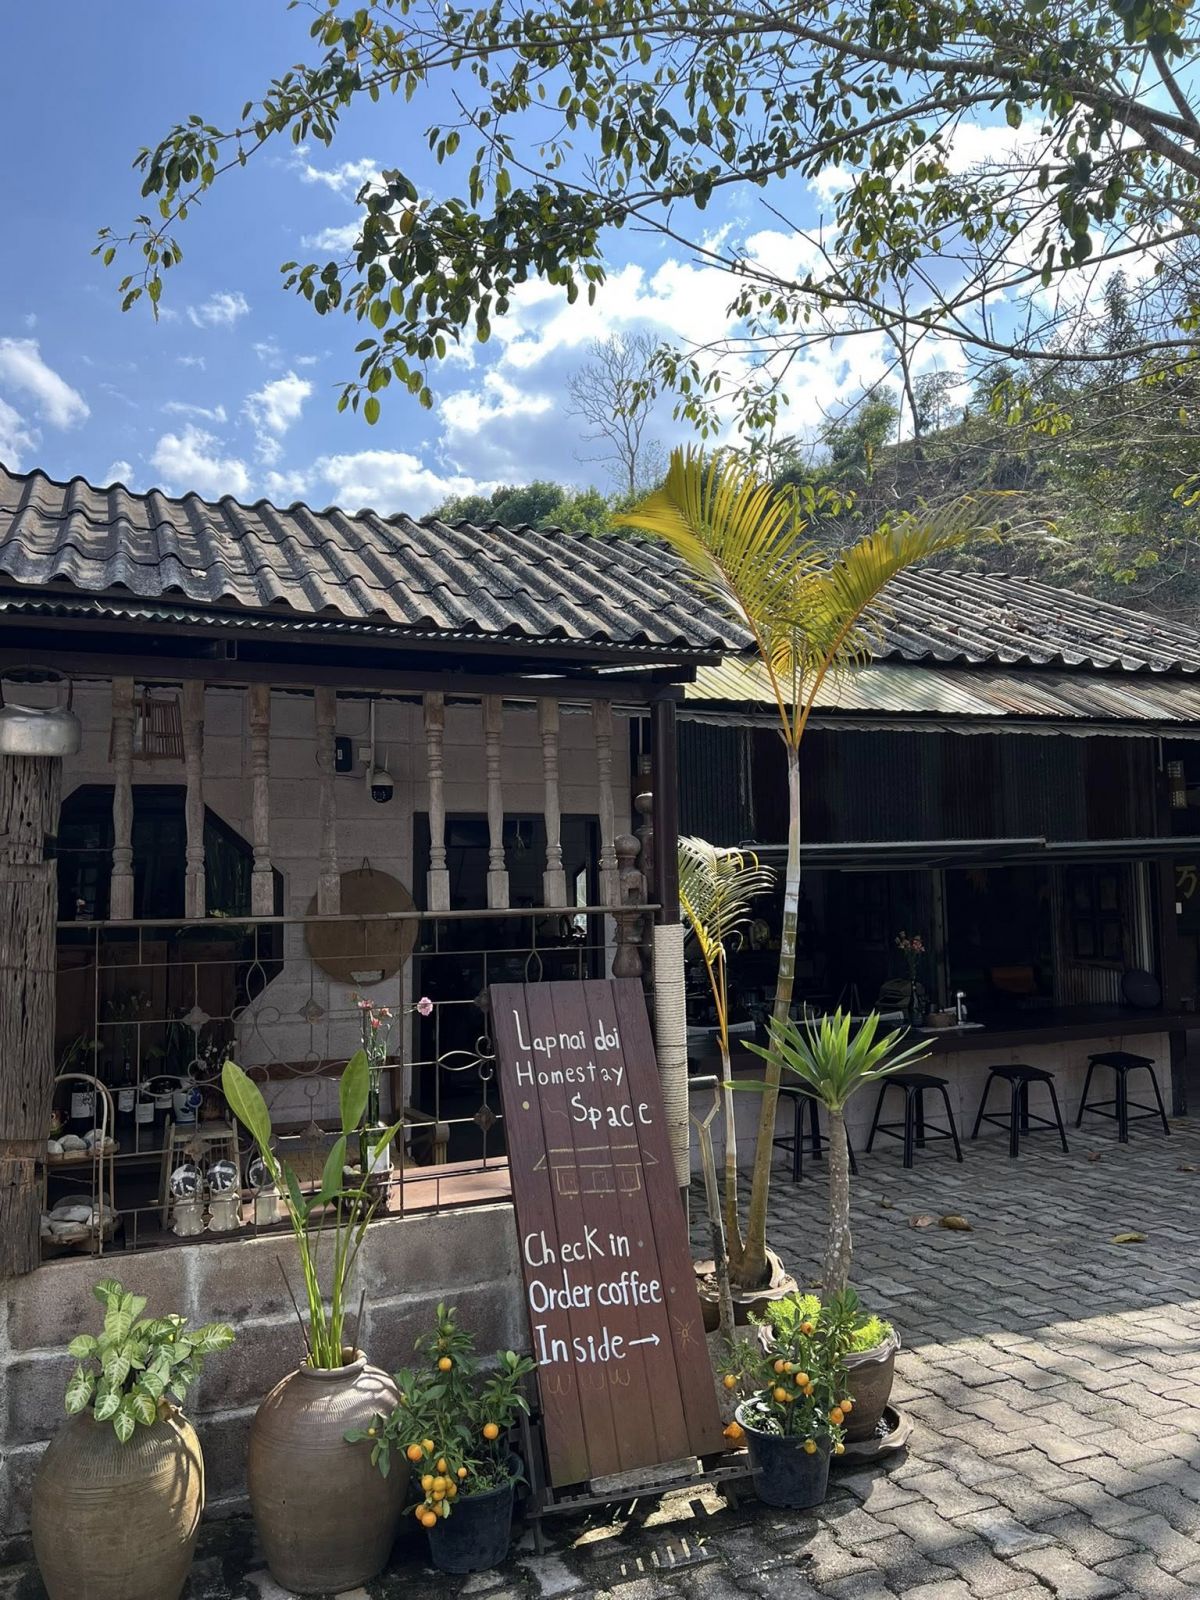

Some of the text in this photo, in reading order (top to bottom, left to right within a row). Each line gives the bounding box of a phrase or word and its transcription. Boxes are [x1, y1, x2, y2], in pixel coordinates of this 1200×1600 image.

[512, 1010, 620, 1059] Lapnai doi
[515, 1060, 623, 1086] Homestay
[570, 1092, 653, 1130] Space
[609, 1233, 630, 1257] in
[528, 1268, 662, 1313] Order coffee
[535, 1325, 626, 1365] Inside
